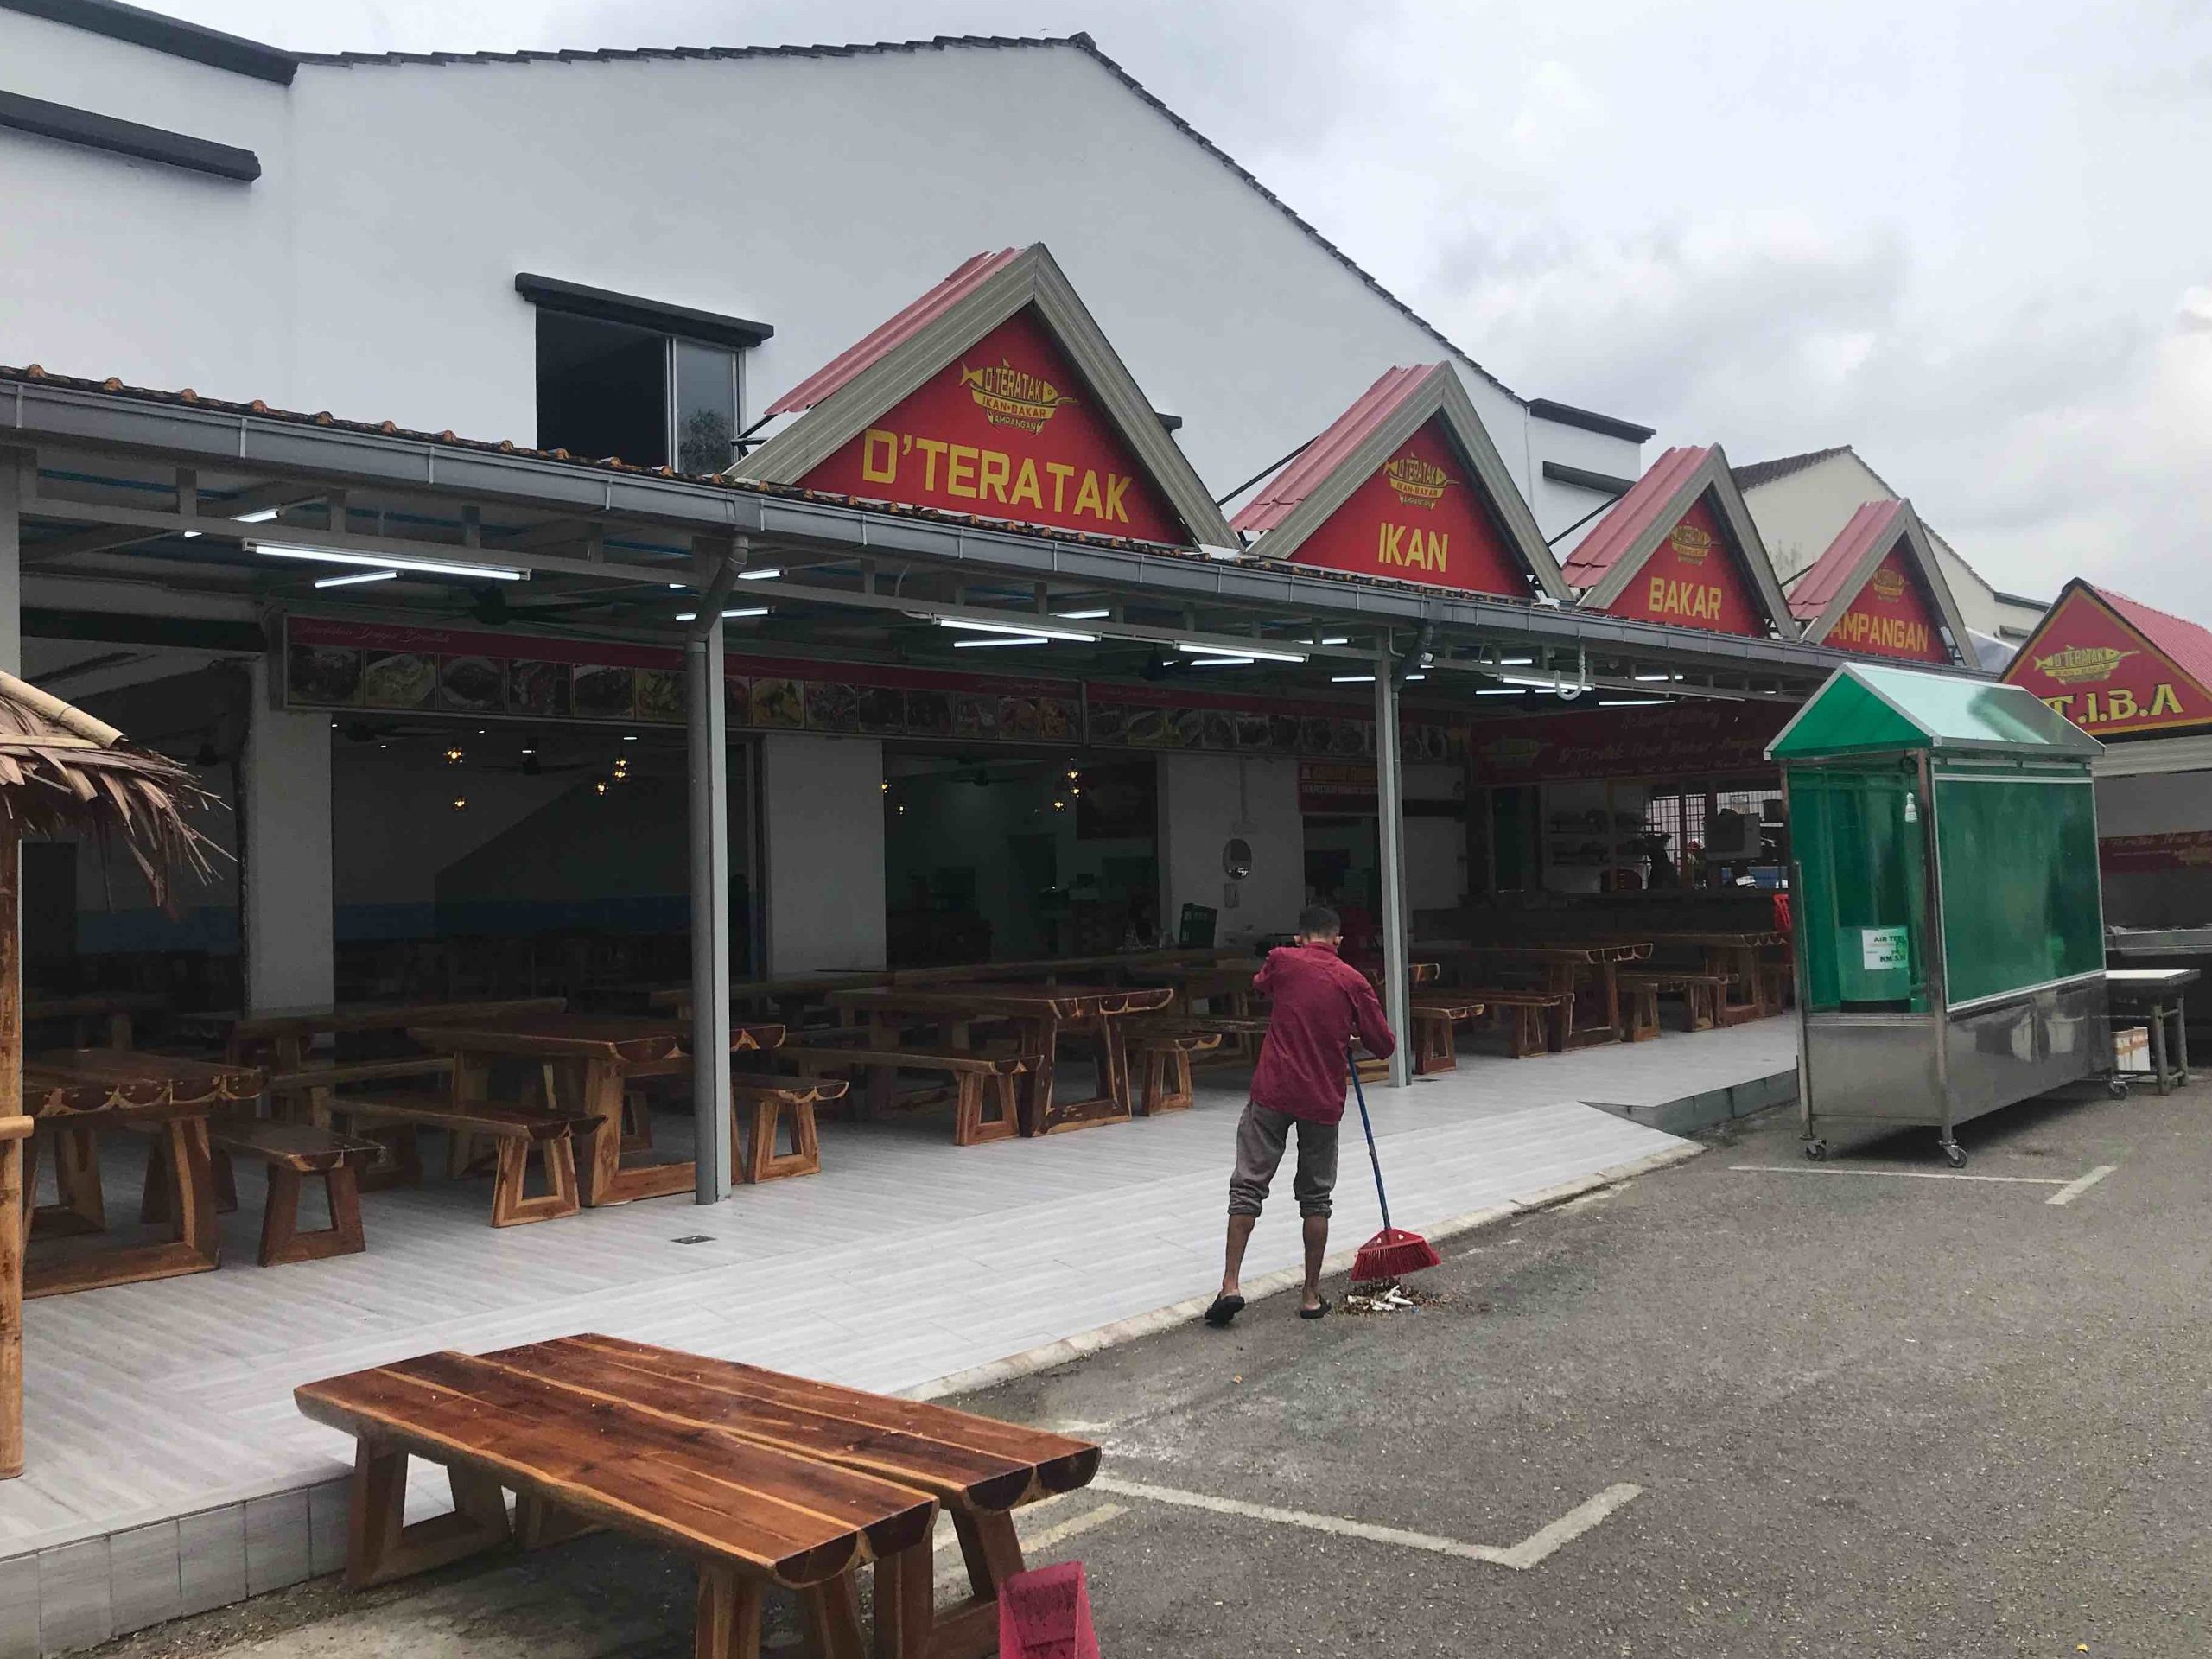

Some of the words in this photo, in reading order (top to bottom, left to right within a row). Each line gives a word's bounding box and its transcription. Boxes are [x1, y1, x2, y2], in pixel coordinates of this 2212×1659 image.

[994, 415, 1037, 430] AMPANGAN
[862, 429, 1134, 523] D'TERATAK
[1378, 522, 1449, 573] IKAN
[1649, 576, 1722, 620] BAKAR
